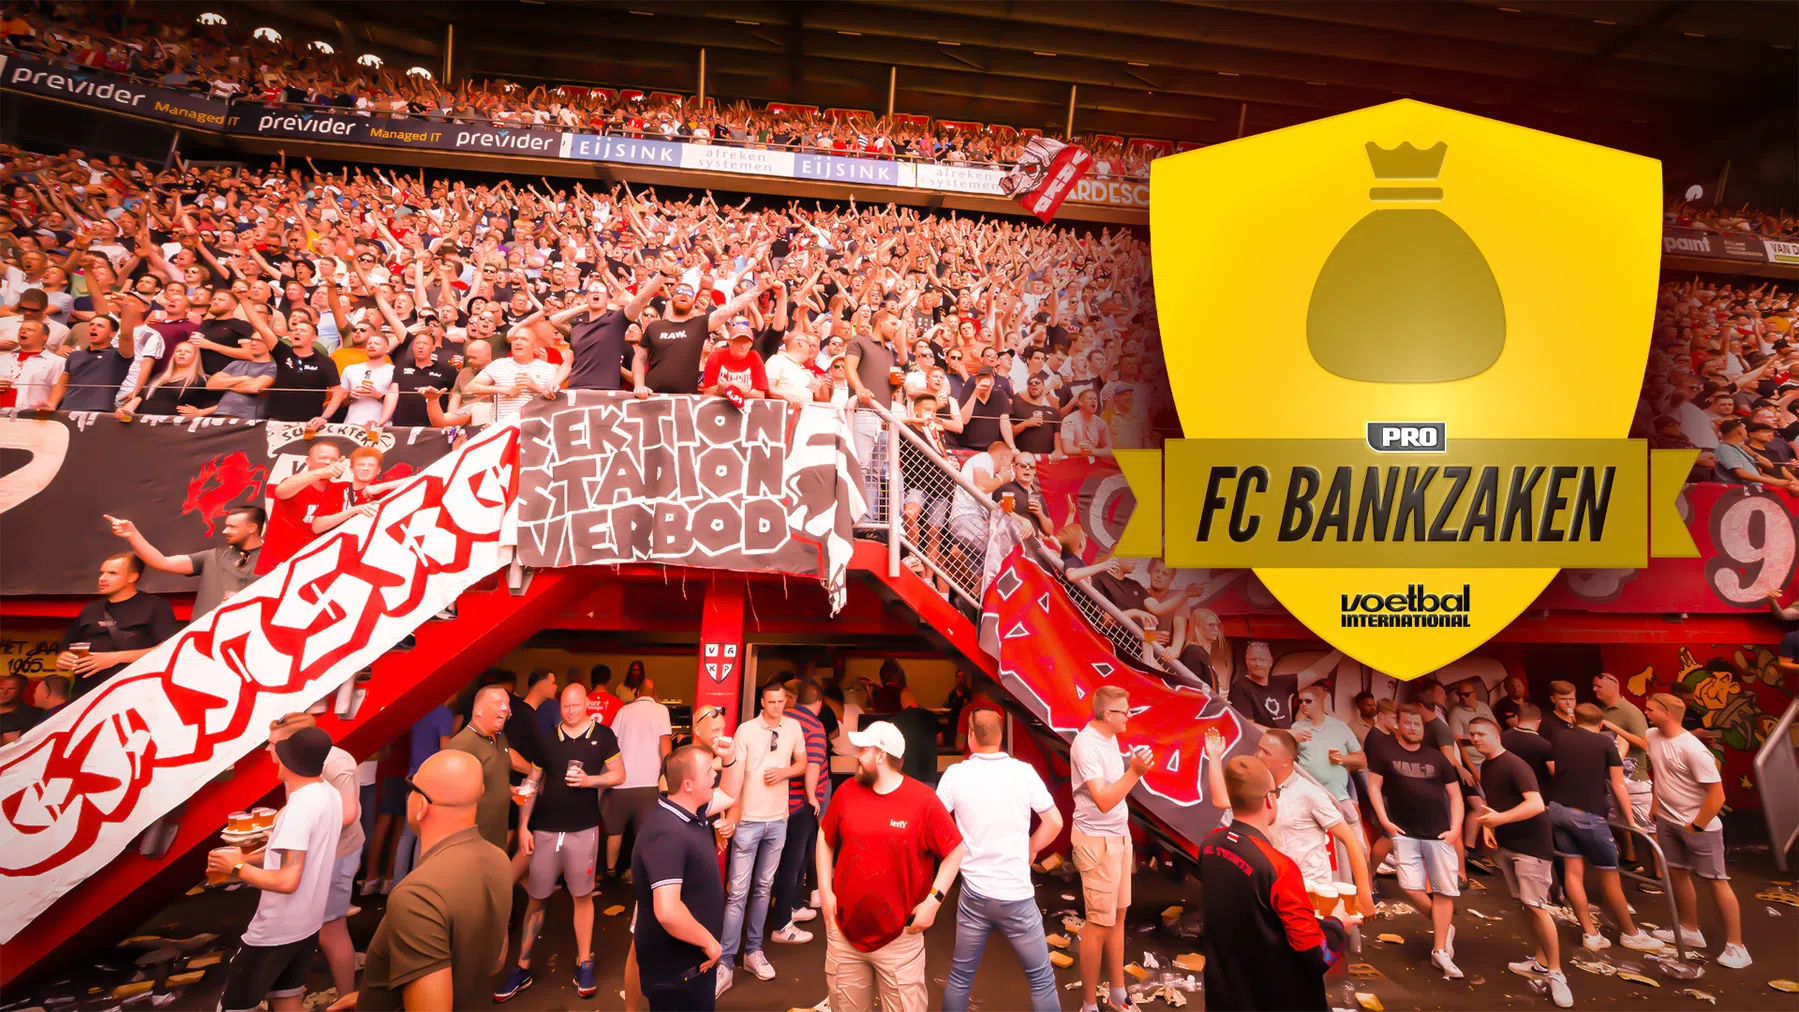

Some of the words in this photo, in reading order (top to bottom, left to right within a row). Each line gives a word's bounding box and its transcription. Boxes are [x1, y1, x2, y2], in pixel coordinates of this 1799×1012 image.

[11, 67, 146, 107] previder
[154, 101, 225, 126] Managed
[228, 116, 240, 127] IT
[258, 113, 356, 136] previder
[369, 127, 428, 142] Managed
[430, 132, 442, 142] IT
[456, 131, 553, 151] previder
[698, 158, 773, 172] systemen
[706, 148, 766, 162] afreken
[929, 177, 1000, 191] systemen
[936, 168, 993, 181] afreken
[519, 397, 788, 470] SEKTION
[517, 445, 787, 523] STADION
[517, 498, 790, 567] VERBOD
